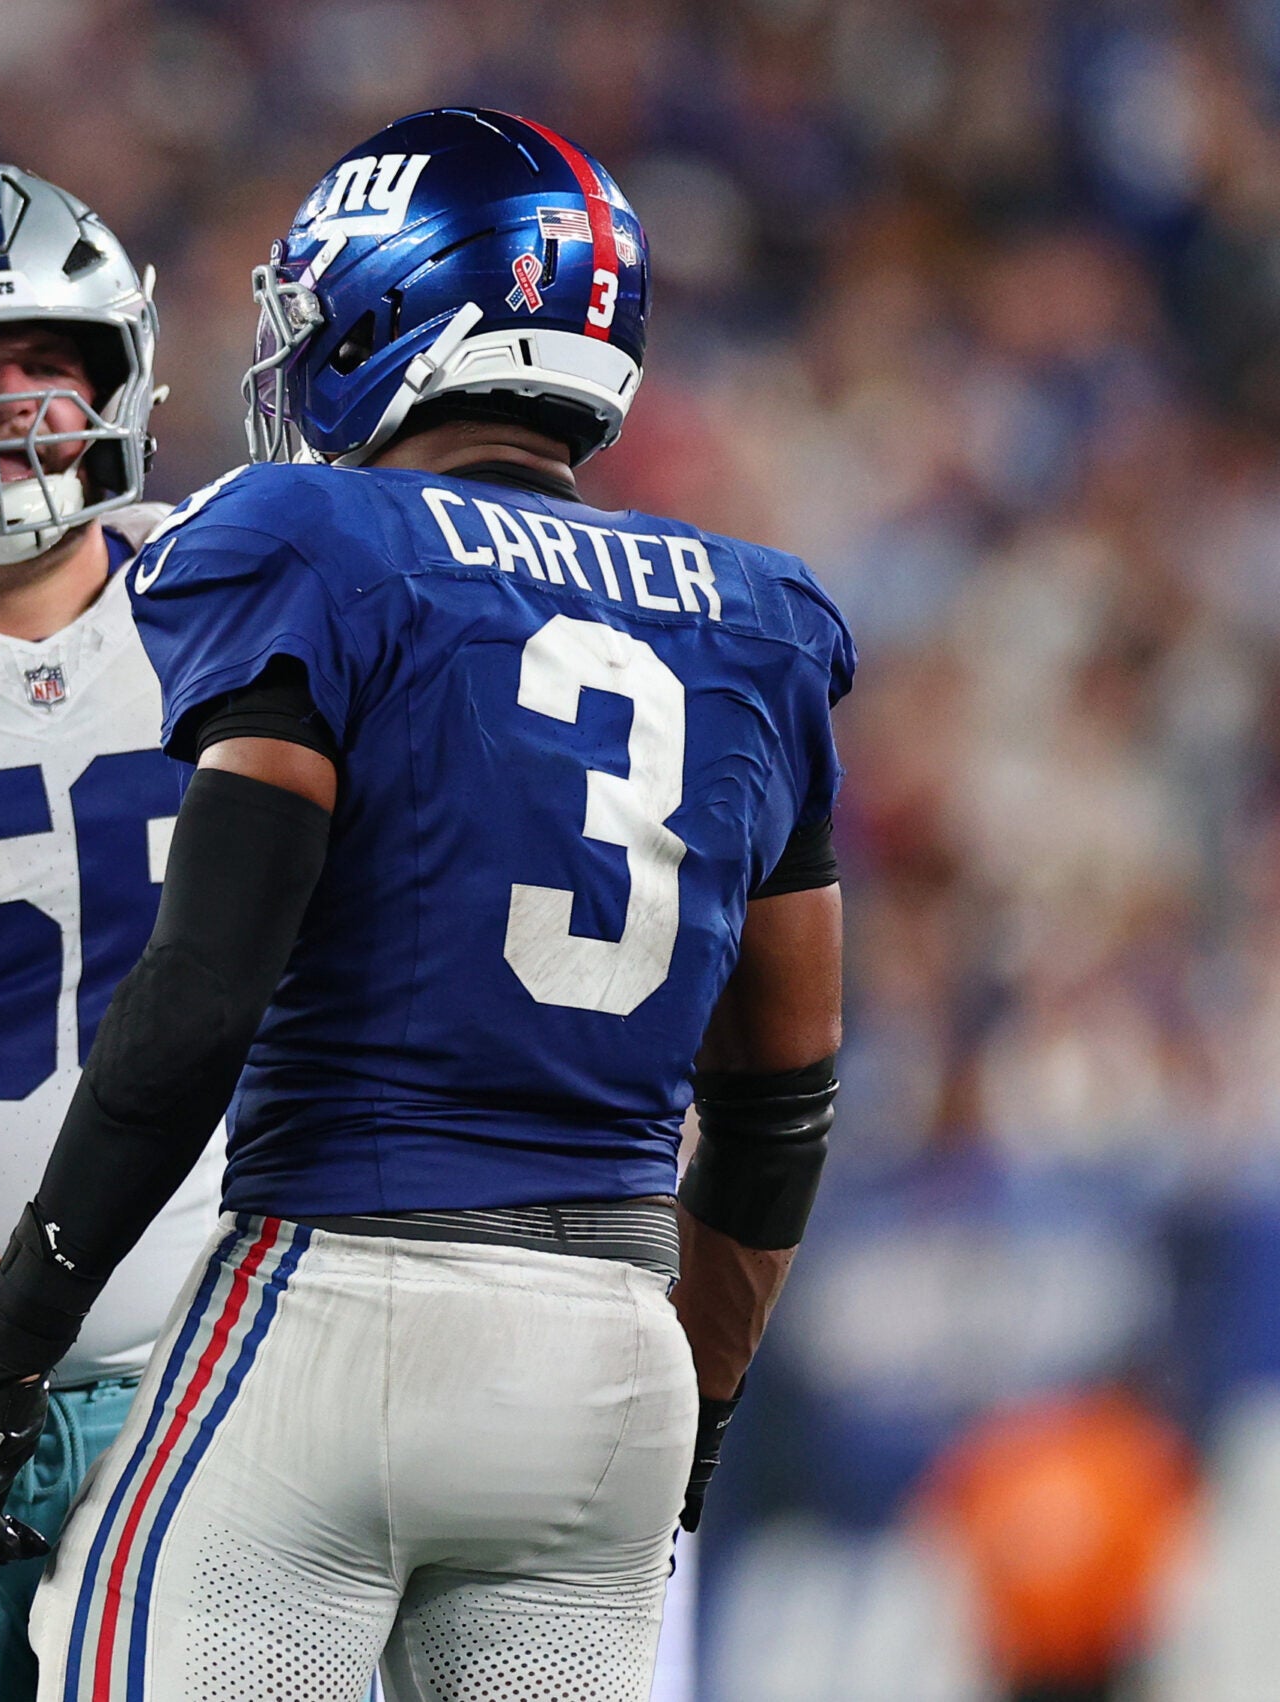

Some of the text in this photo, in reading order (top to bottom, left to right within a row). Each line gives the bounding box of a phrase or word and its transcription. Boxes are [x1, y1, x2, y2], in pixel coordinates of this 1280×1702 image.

[586, 267, 619, 329] 3
[421, 487, 722, 622] CARTER
[33, 679, 63, 700] NFL
[503, 613, 687, 1017] 3
